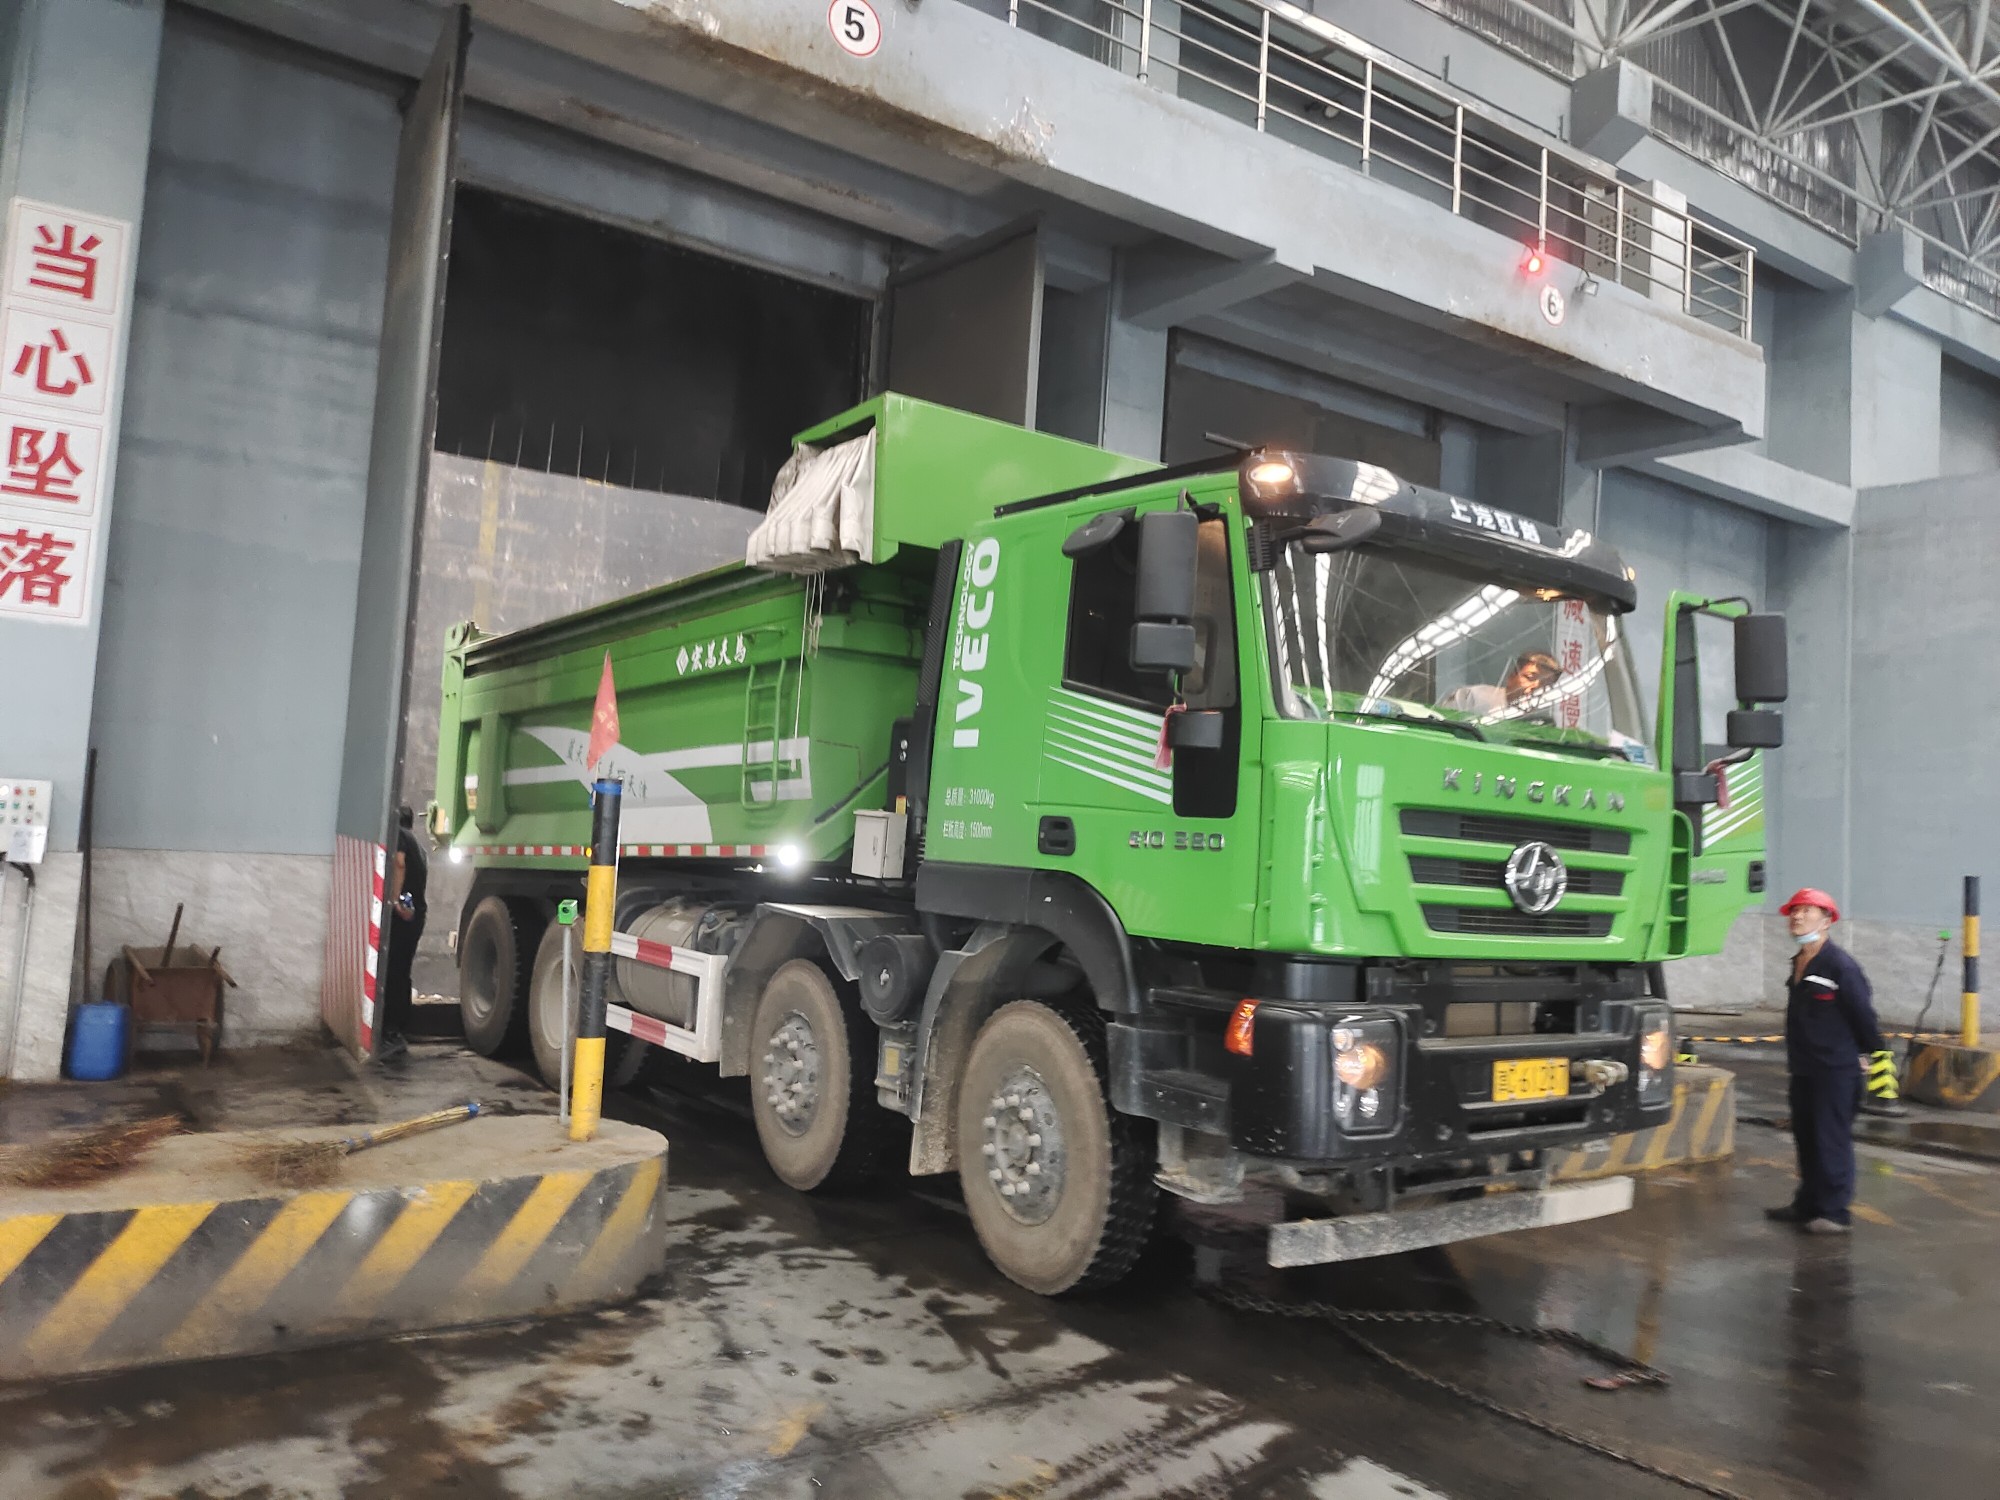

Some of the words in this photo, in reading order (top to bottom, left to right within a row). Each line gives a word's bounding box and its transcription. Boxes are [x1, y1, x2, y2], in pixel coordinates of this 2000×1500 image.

[844, 5, 866, 43] 5
[1547, 292, 1559, 317] 6
[0, 224, 102, 605] 当心坠落
[952, 541, 976, 671] TECHNOLOGY
[952, 537, 1001, 748] IVECO
[1443, 766, 1625, 813] KINGKAN
